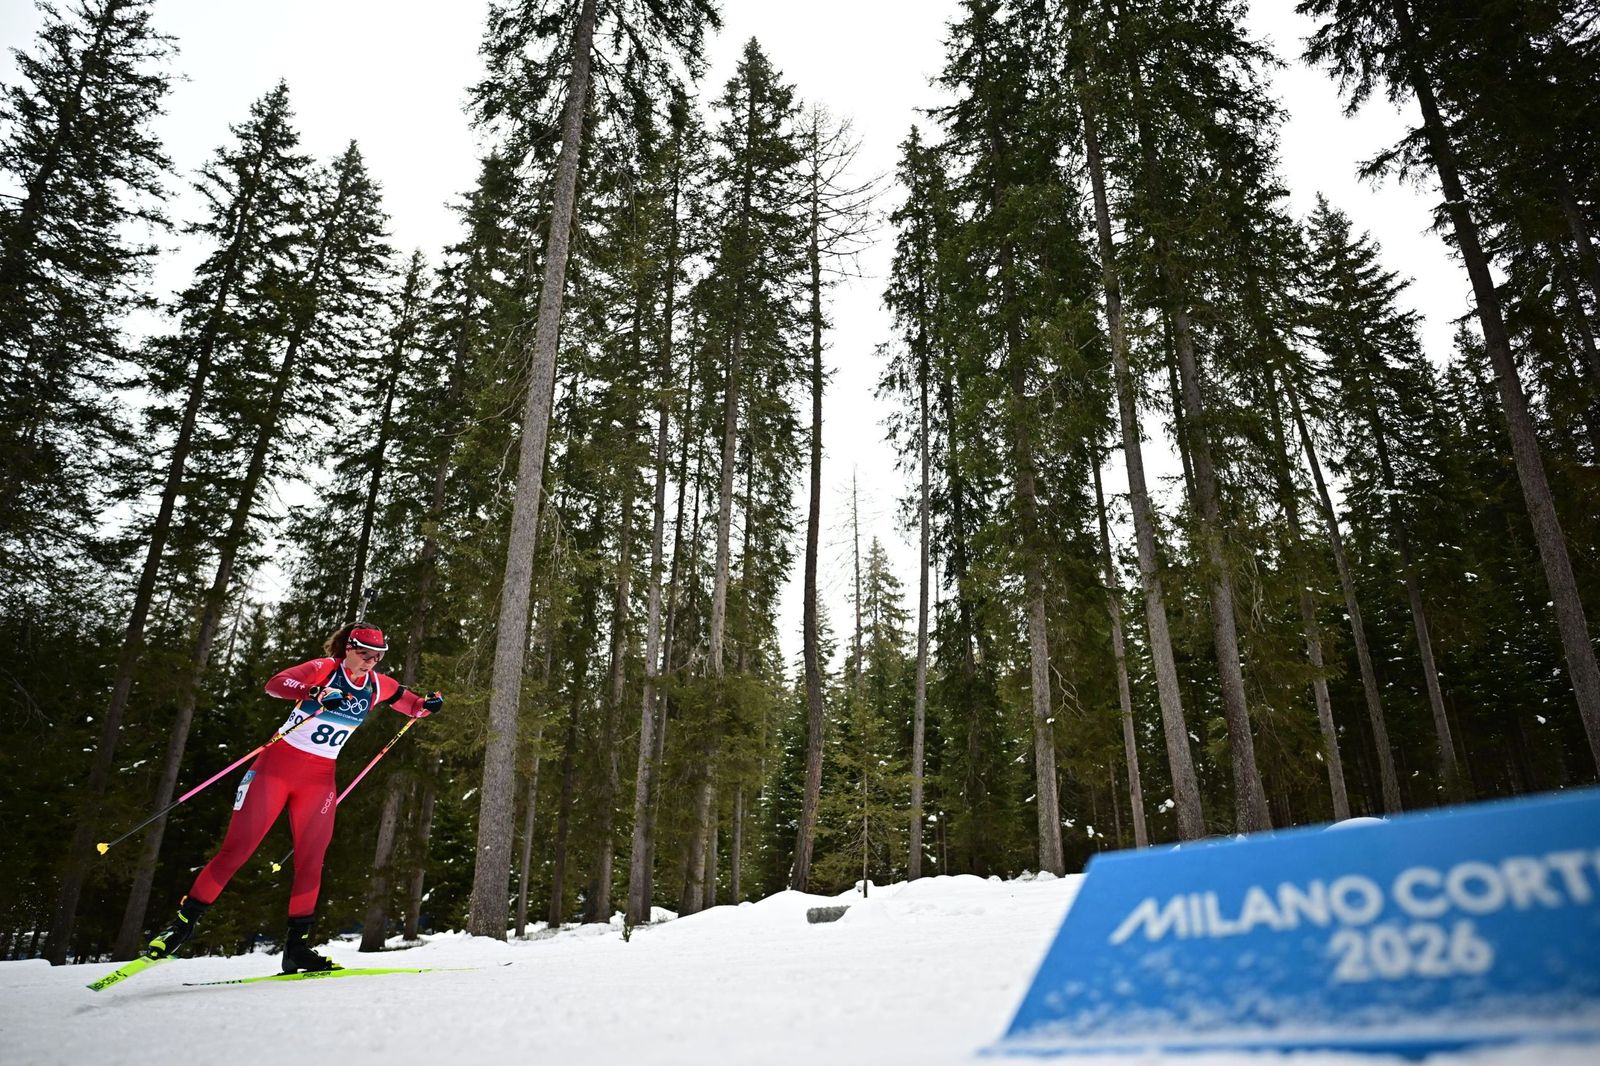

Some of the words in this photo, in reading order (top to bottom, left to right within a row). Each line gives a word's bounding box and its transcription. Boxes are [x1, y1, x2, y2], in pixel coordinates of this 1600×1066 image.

[311, 723, 350, 747] 80
[1110, 874, 1383, 945] MILANO
[1328, 919, 1495, 984] 2026
